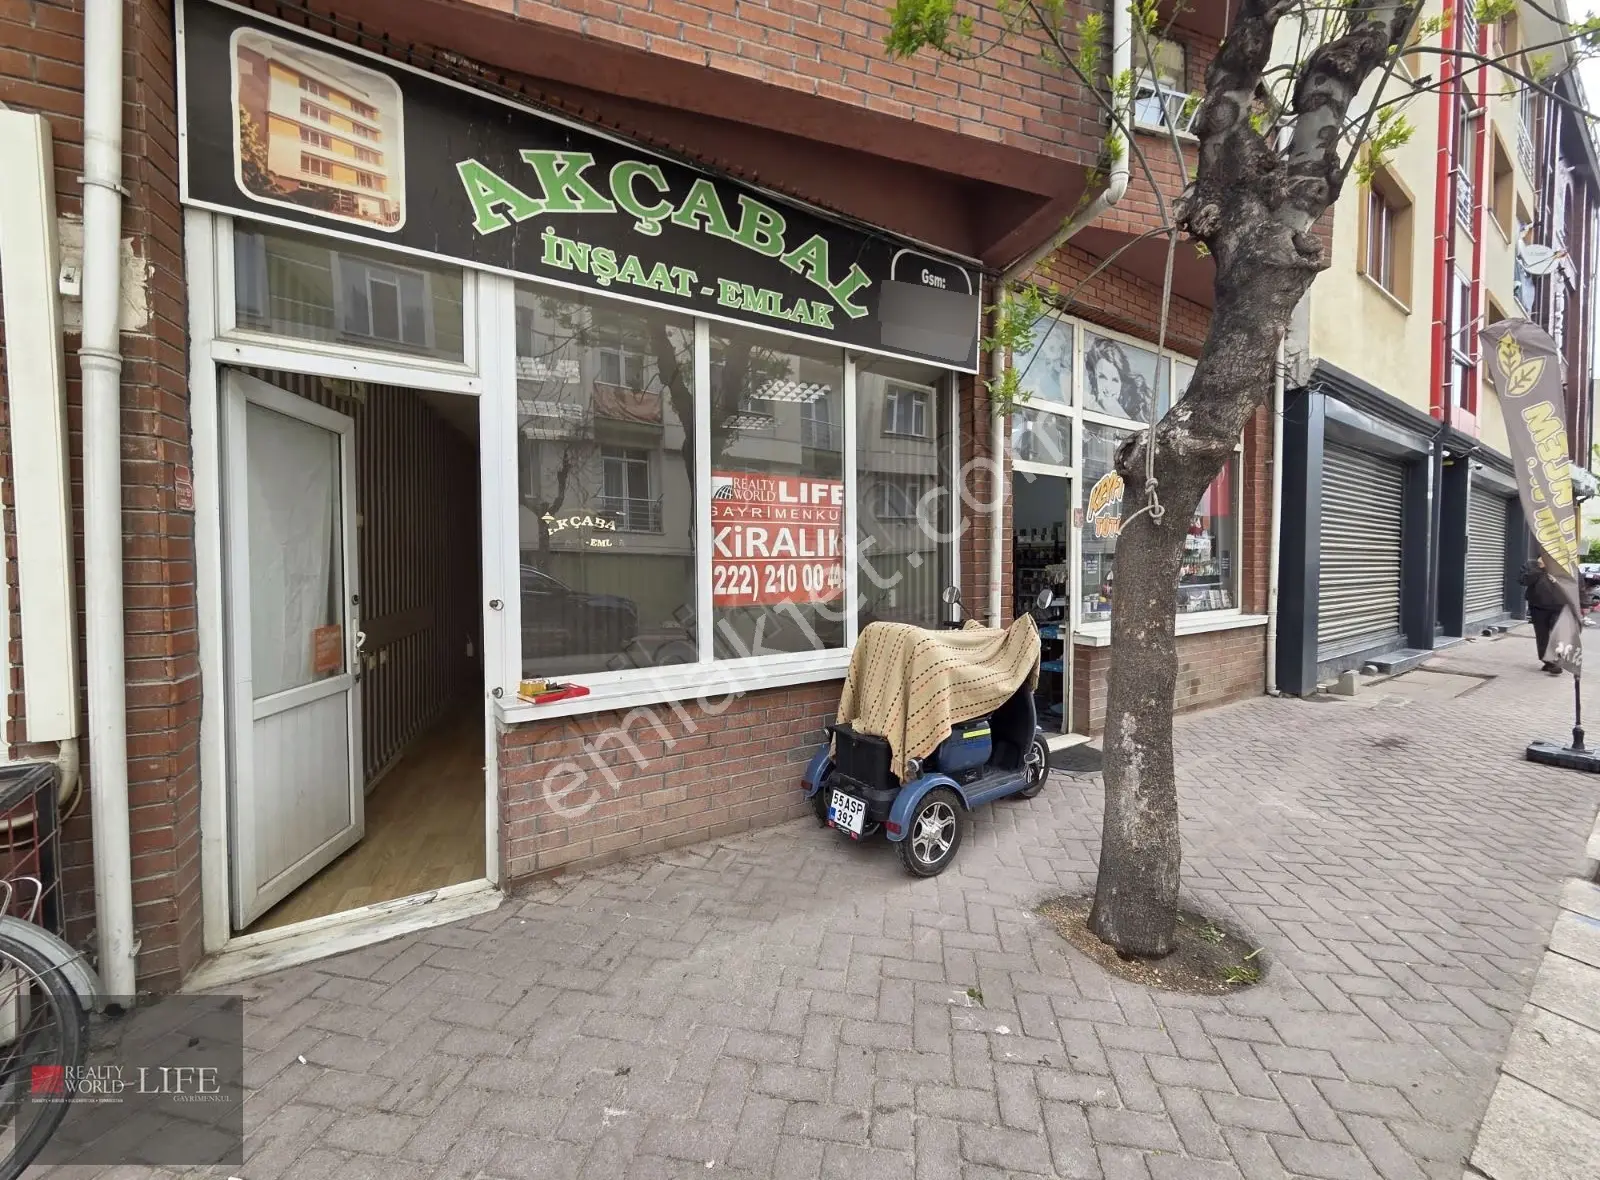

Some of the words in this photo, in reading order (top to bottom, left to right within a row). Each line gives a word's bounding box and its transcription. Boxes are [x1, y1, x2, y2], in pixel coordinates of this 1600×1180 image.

[456, 149, 872, 319] AKÇABAL
[541, 226, 698, 296] İNŞAAT
[717, 278, 834, 329] EMLAK
[921, 268, 947, 289] Gsm:
[733, 477, 776, 491] REALTY
[734, 489, 777, 502] WORLD
[779, 481, 844, 505] LIFE
[765, 564, 797, 593] 210
[802, 563, 824, 592] 00
[837, 810, 854, 827] 392
